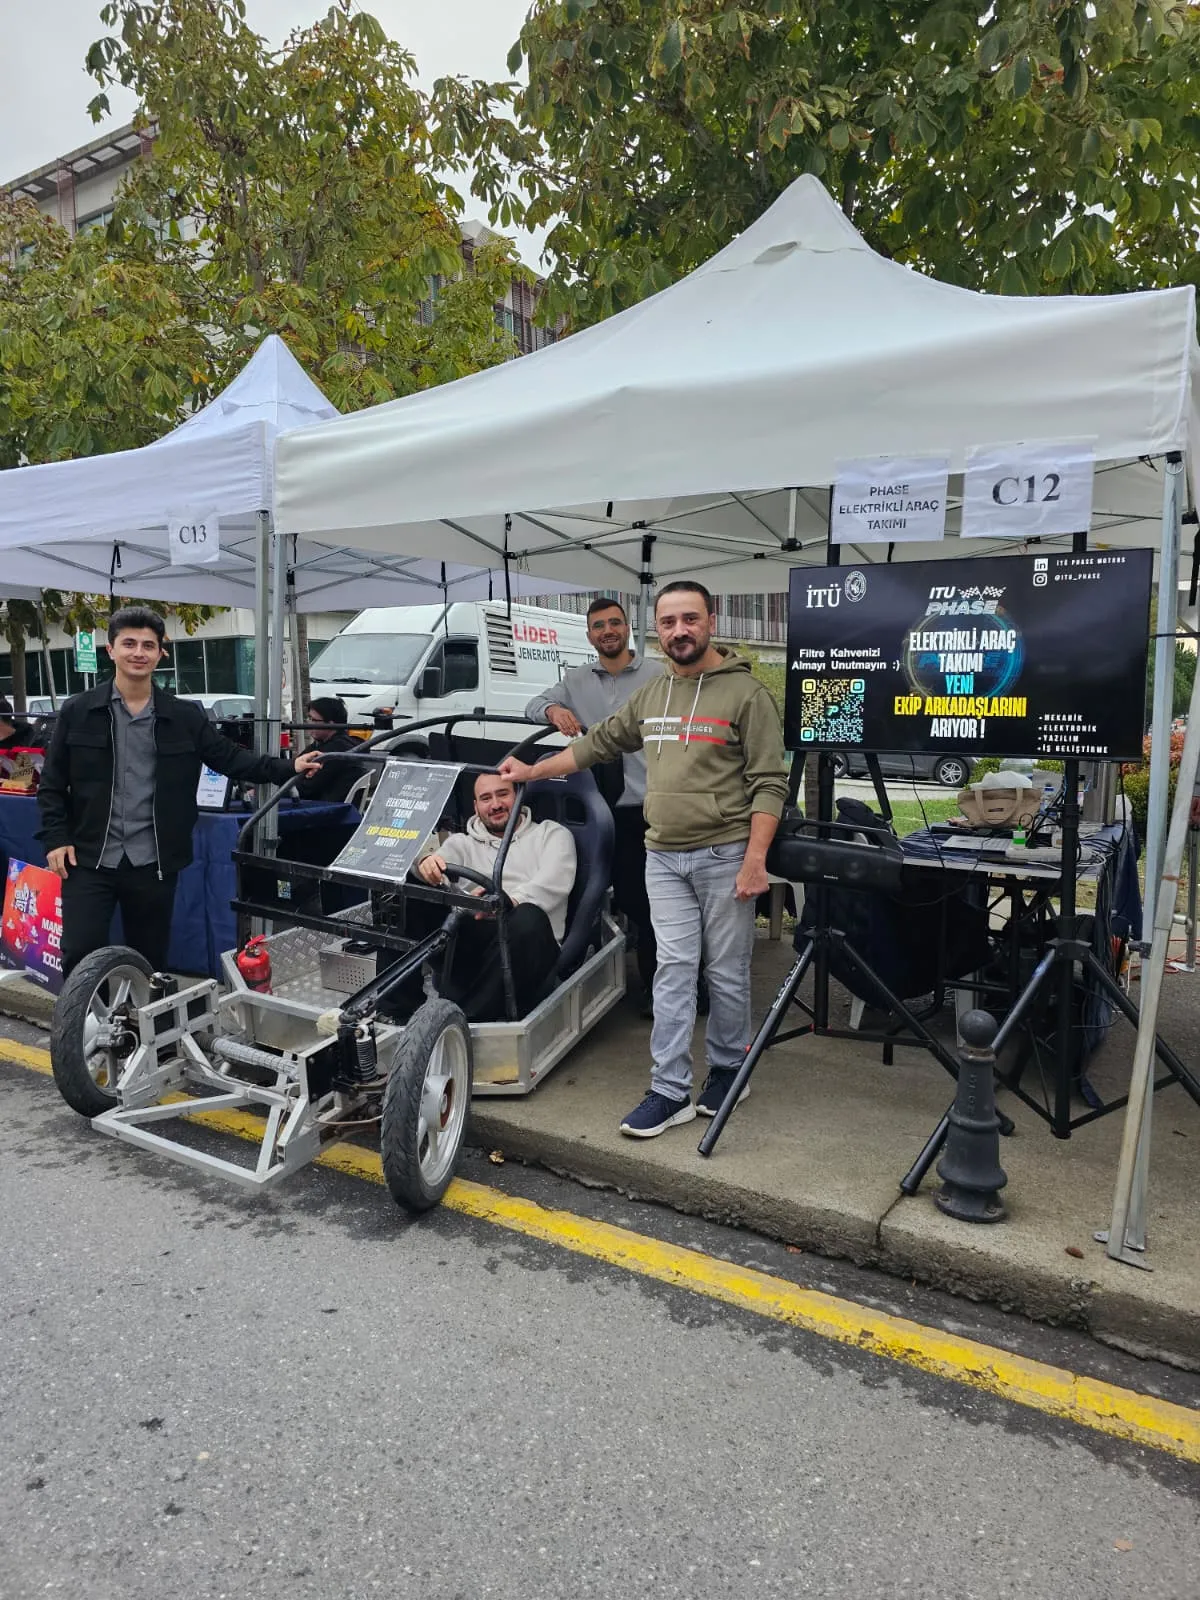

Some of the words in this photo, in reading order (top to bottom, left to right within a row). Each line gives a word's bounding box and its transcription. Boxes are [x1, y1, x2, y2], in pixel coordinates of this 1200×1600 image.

[870, 484, 909, 497] PHASE
[992, 473, 1061, 505] C12
[839, 499, 903, 515] ELEKTRİKLİ
[905, 500, 940, 513] ARAÇ
[179, 524, 207, 544] C13
[867, 518, 906, 530] TAKIMI
[805, 583, 842, 608] İTÜ
[929, 586, 956, 599] ITU
[925, 599, 999, 616] PHASE
[513, 620, 559, 645] LİDER
[909, 628, 977, 651] ELEKTRİKLİ
[979, 629, 1016, 653] ARAÇ
[518, 646, 561, 663] JENERATÖR
[800, 648, 825, 658] Filtre
[830, 648, 881, 658] Kahvenizi
[938, 652, 983, 673] TAKIMI
[791, 660, 826, 672] Almayı
[831, 660, 887, 672] Unutmayın
[945, 672, 974, 694] YENİ
[894, 694, 922, 715] EKİP
[924, 696, 1027, 719] ARKADAŞLARINI
[930, 718, 977, 738] ARIYOR
